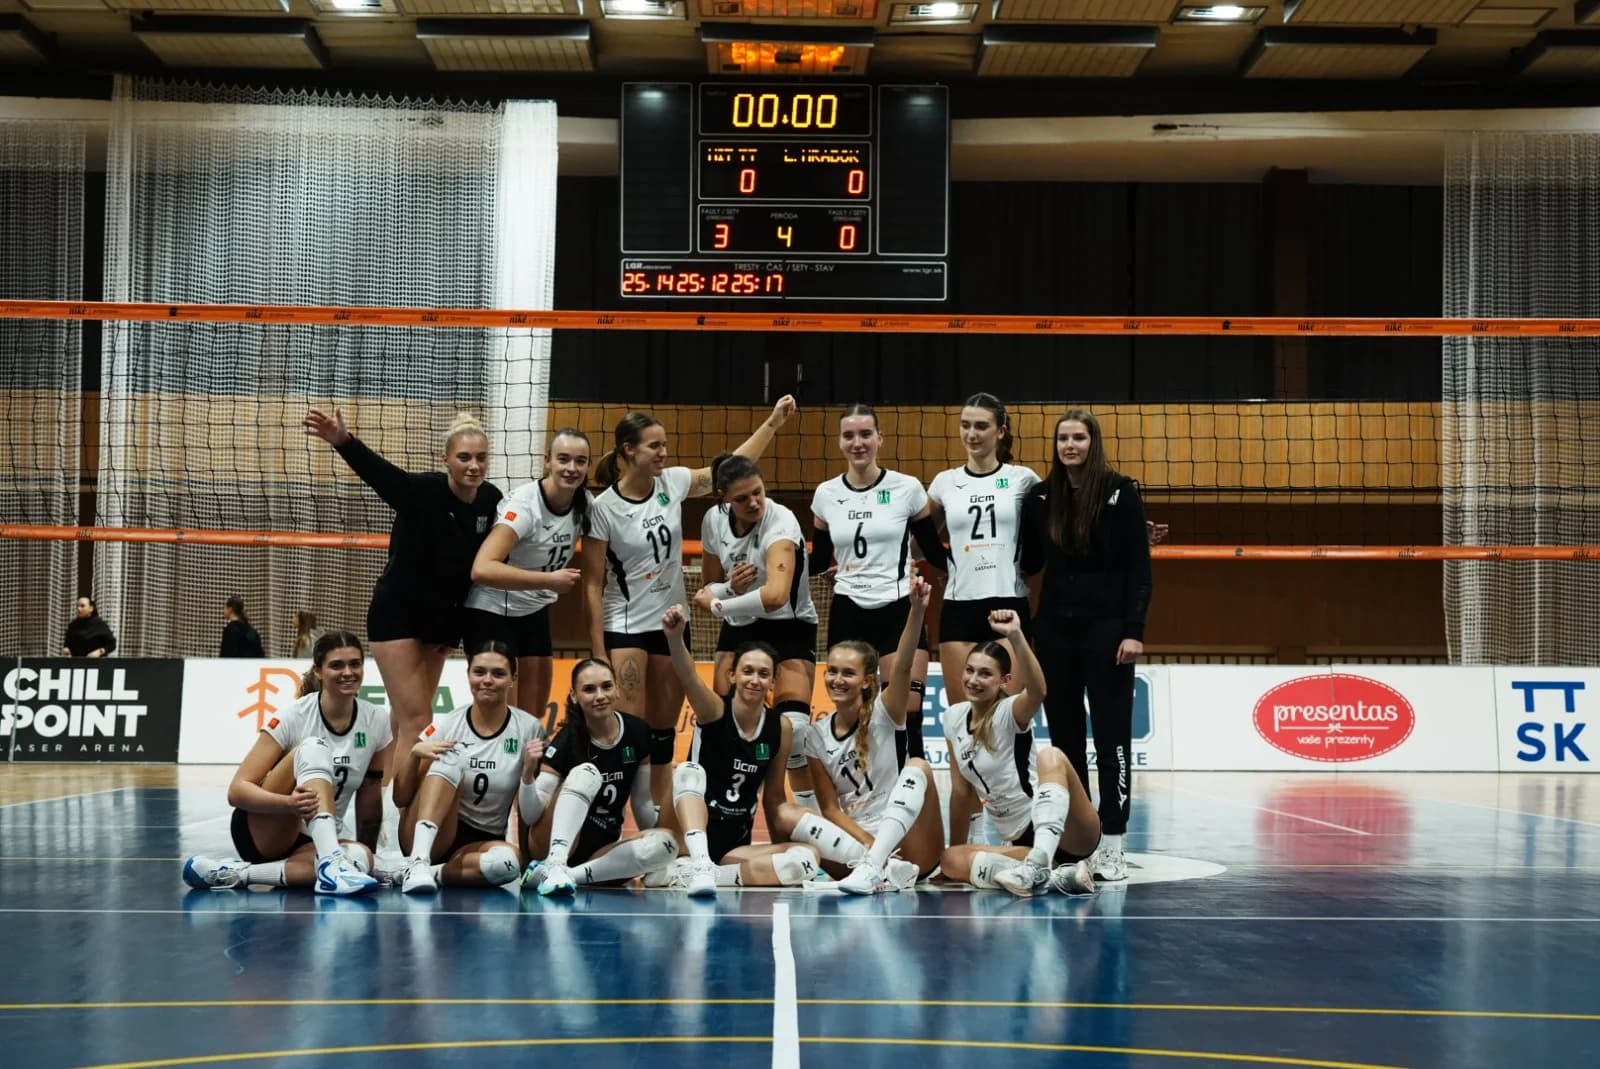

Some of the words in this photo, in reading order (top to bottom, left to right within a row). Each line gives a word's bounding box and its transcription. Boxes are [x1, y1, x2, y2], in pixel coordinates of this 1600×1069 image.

[740, 169, 756, 193] 0
[848, 170, 864, 194] 0
[714, 224, 729, 248] 3
[777, 226, 792, 247] 4
[840, 226, 855, 249] 0
[967, 504, 997, 540] 21
[646, 524, 672, 564] 19
[853, 522, 868, 558] 6
[3, 668, 139, 701] CHILL
[1512, 681, 1585, 713] TT
[0, 704, 148, 737] POINT
[1274, 700, 1399, 733] presentas
[80, 744, 145, 752] ARENA
[1297, 735, 1321, 745] vaše
[1325, 734, 1376, 749] prezenty
[1517, 721, 1590, 762] SK
[472, 773, 489, 805] 9
[726, 773, 747, 802] 3
